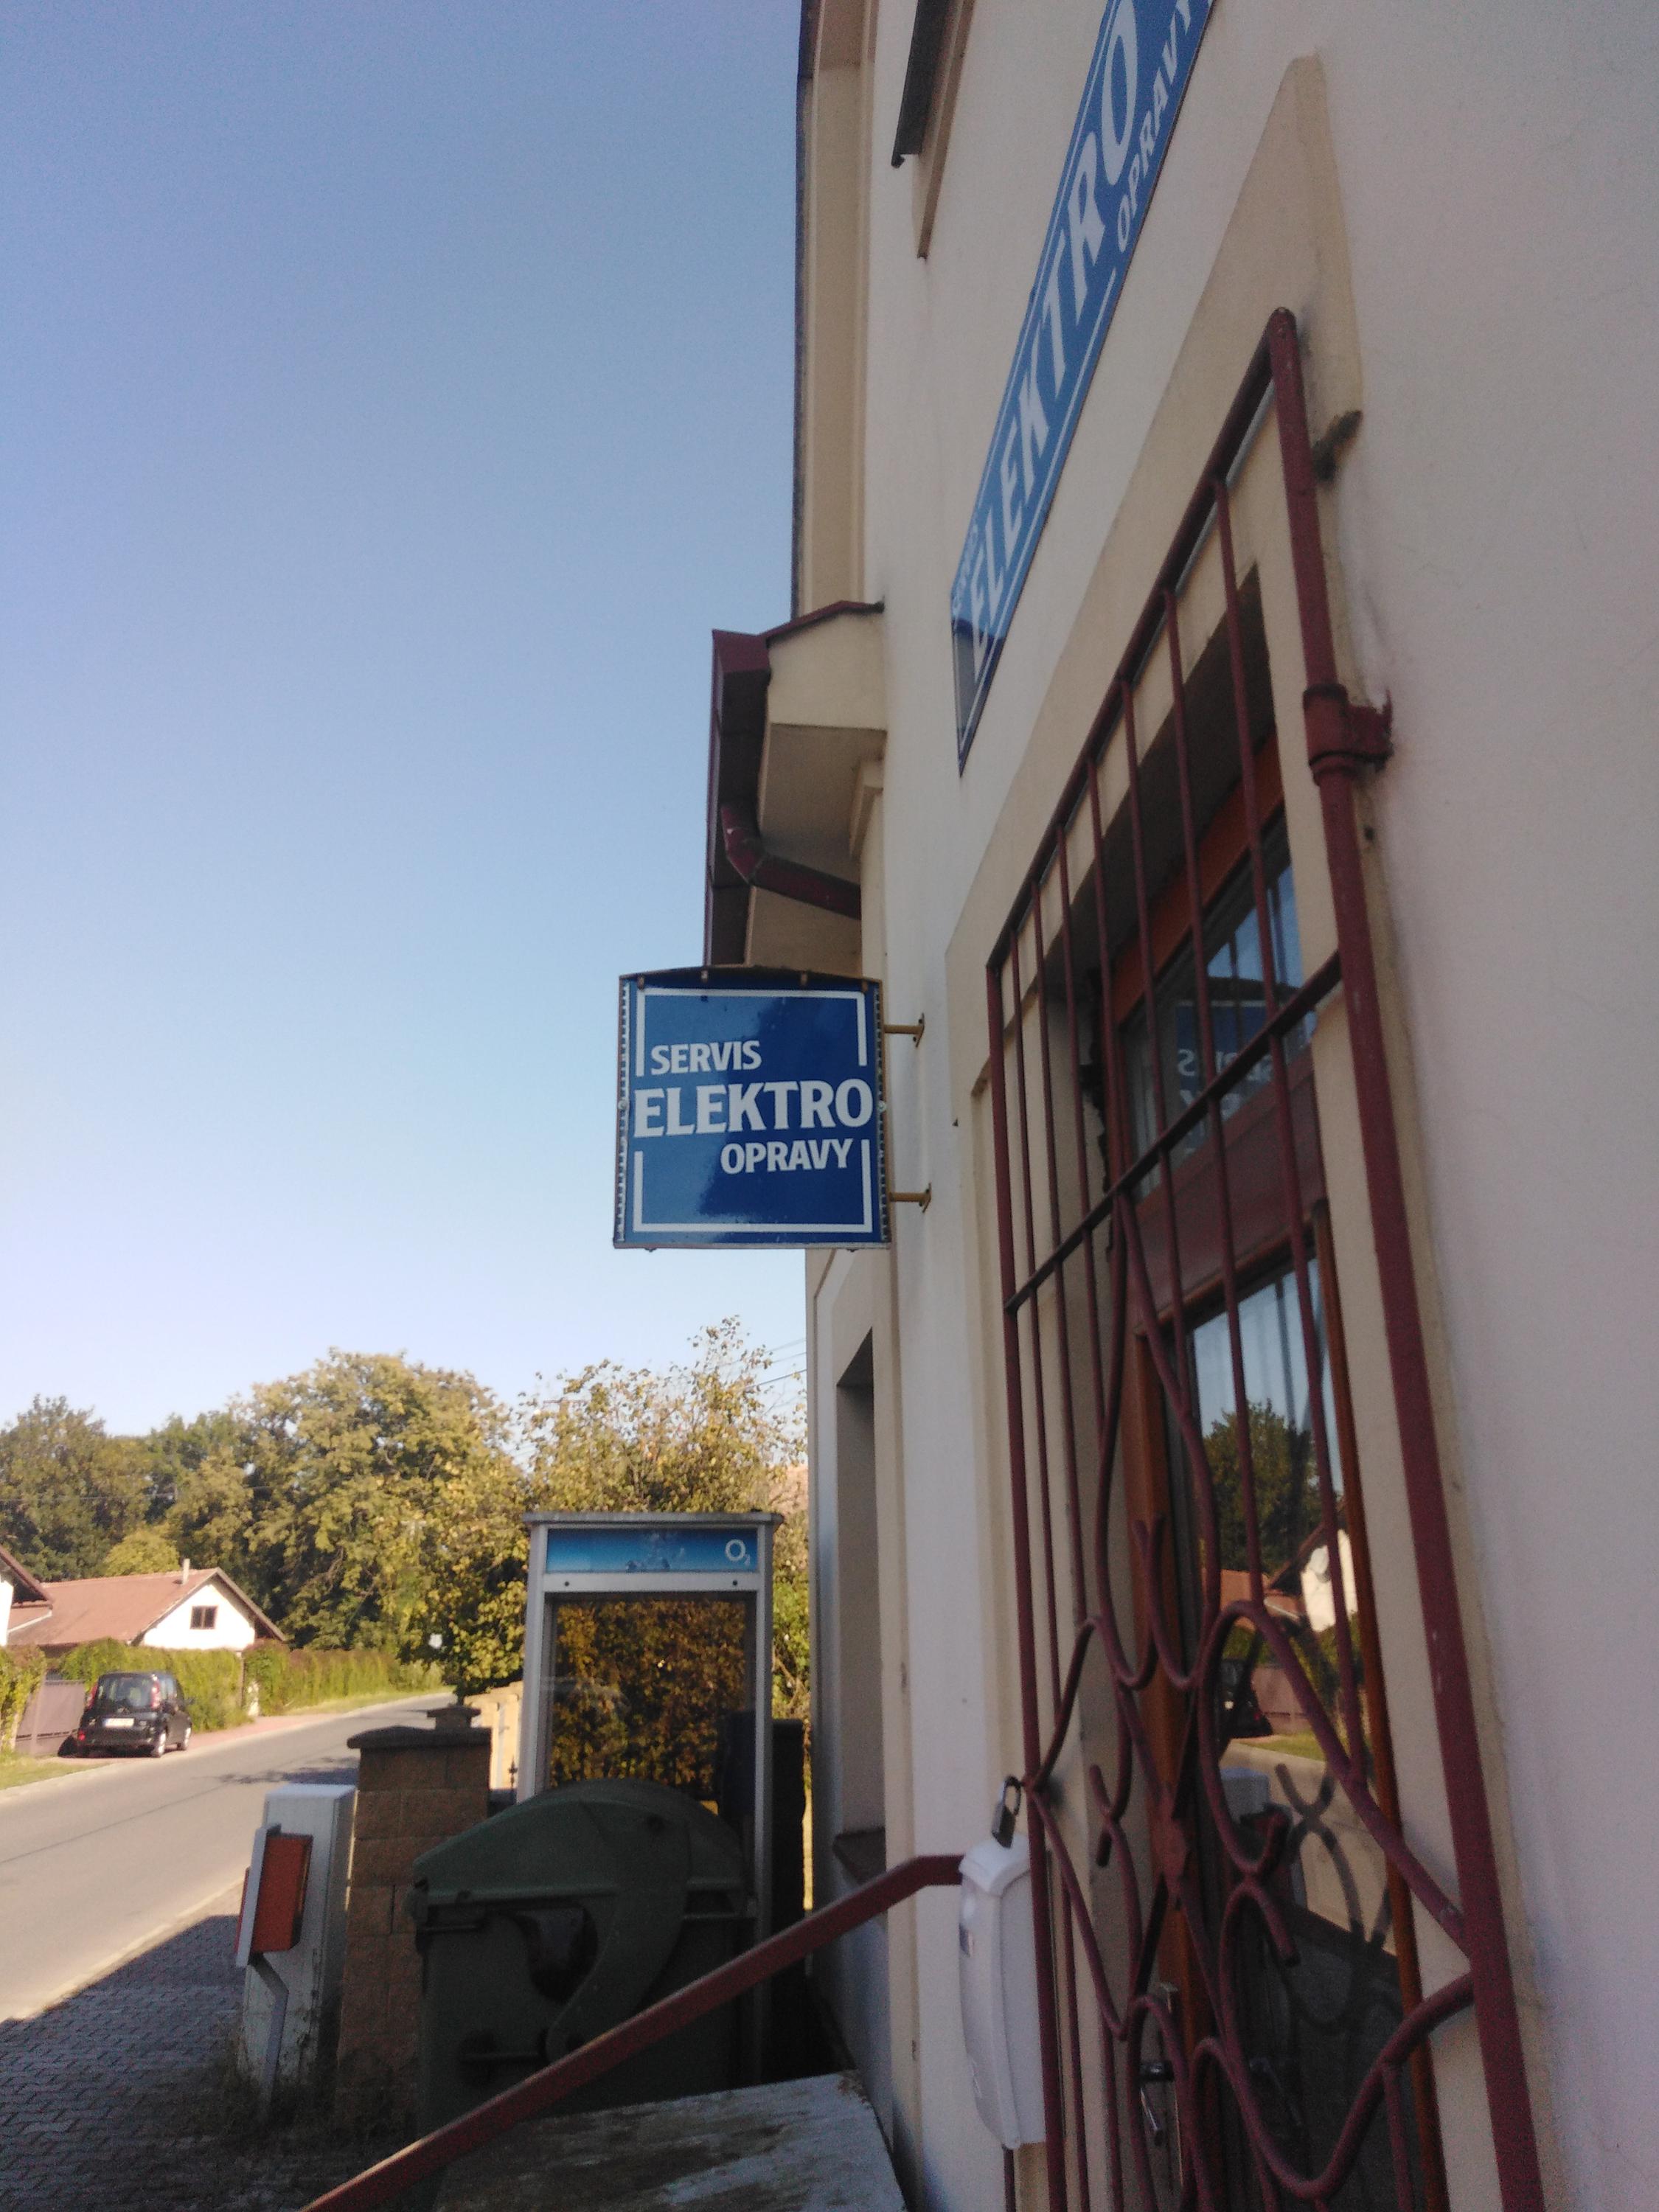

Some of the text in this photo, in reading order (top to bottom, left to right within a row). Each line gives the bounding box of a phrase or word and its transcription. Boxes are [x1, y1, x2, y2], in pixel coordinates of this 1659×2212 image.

[972, 0, 1138, 684] ELEKTRO
[650, 1040, 762, 1077] SERVIS
[633, 1078, 873, 1138] ELEKTRO
[720, 1138, 854, 1175] OPRAVY
